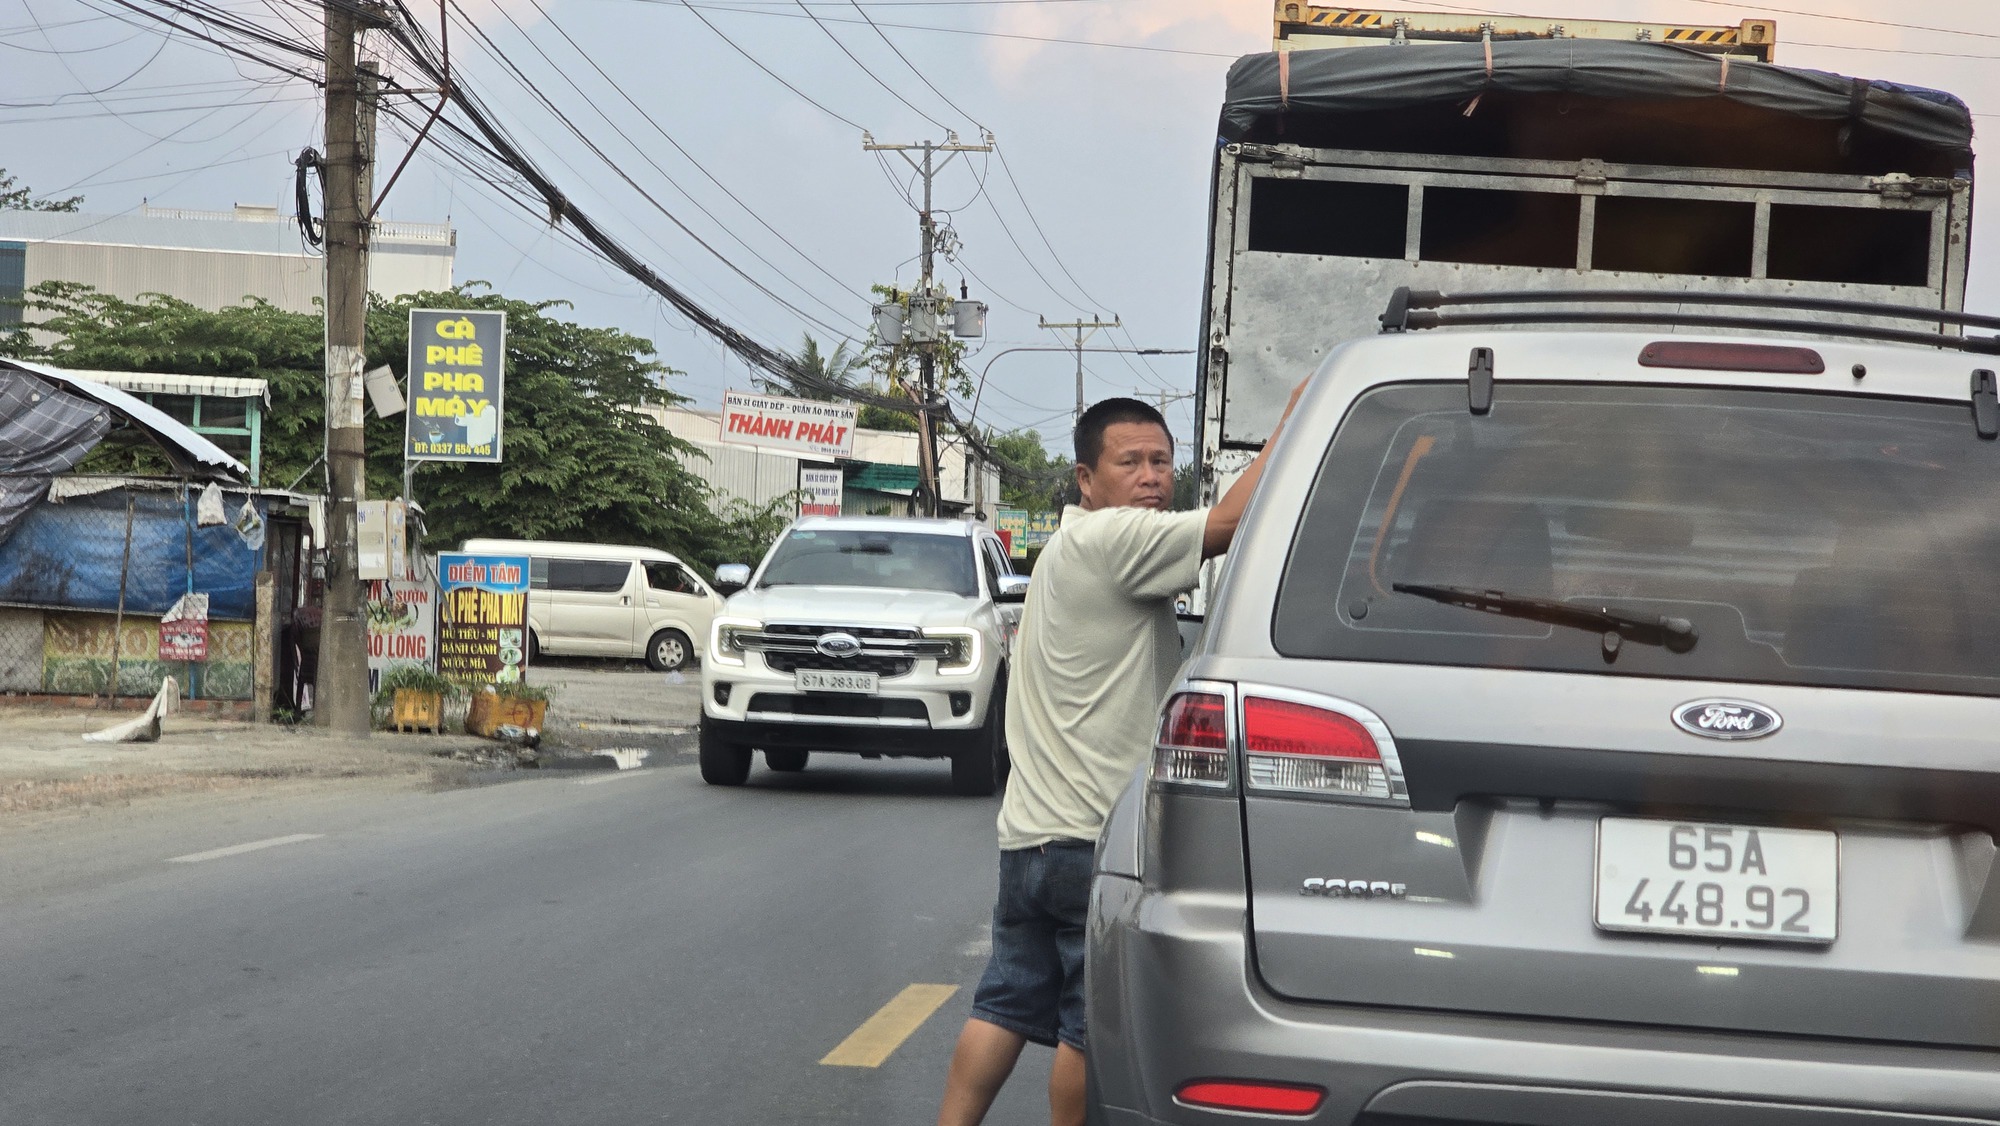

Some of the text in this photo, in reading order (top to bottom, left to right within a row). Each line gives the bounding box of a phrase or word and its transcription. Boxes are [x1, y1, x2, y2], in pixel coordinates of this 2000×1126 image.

[436, 317, 476, 340] CÀ
[426, 343, 483, 367] PHÊ
[423, 371, 485, 393] PHA
[416, 395, 490, 417] MÁY
[728, 411, 847, 446] THÀNH PHÁT
[430, 442, 452, 454] 0337
[455, 443, 472, 455] 554
[474, 444, 491, 455] 445
[448, 559, 521, 584] ĐIỂM TÂM
[395, 588, 428, 604] SƯỜN
[457, 587, 478, 624] PHÊ
[480, 591, 501, 625] PHA
[502, 585, 525, 625] MÁY
[388, 630, 427, 660] LÒNG
[442, 641, 497, 655] BÁNH CANH
[1699, 704, 1754, 730] Ford
[1668, 825, 1767, 876] 65A
[1624, 877, 1810, 933] 448.92
